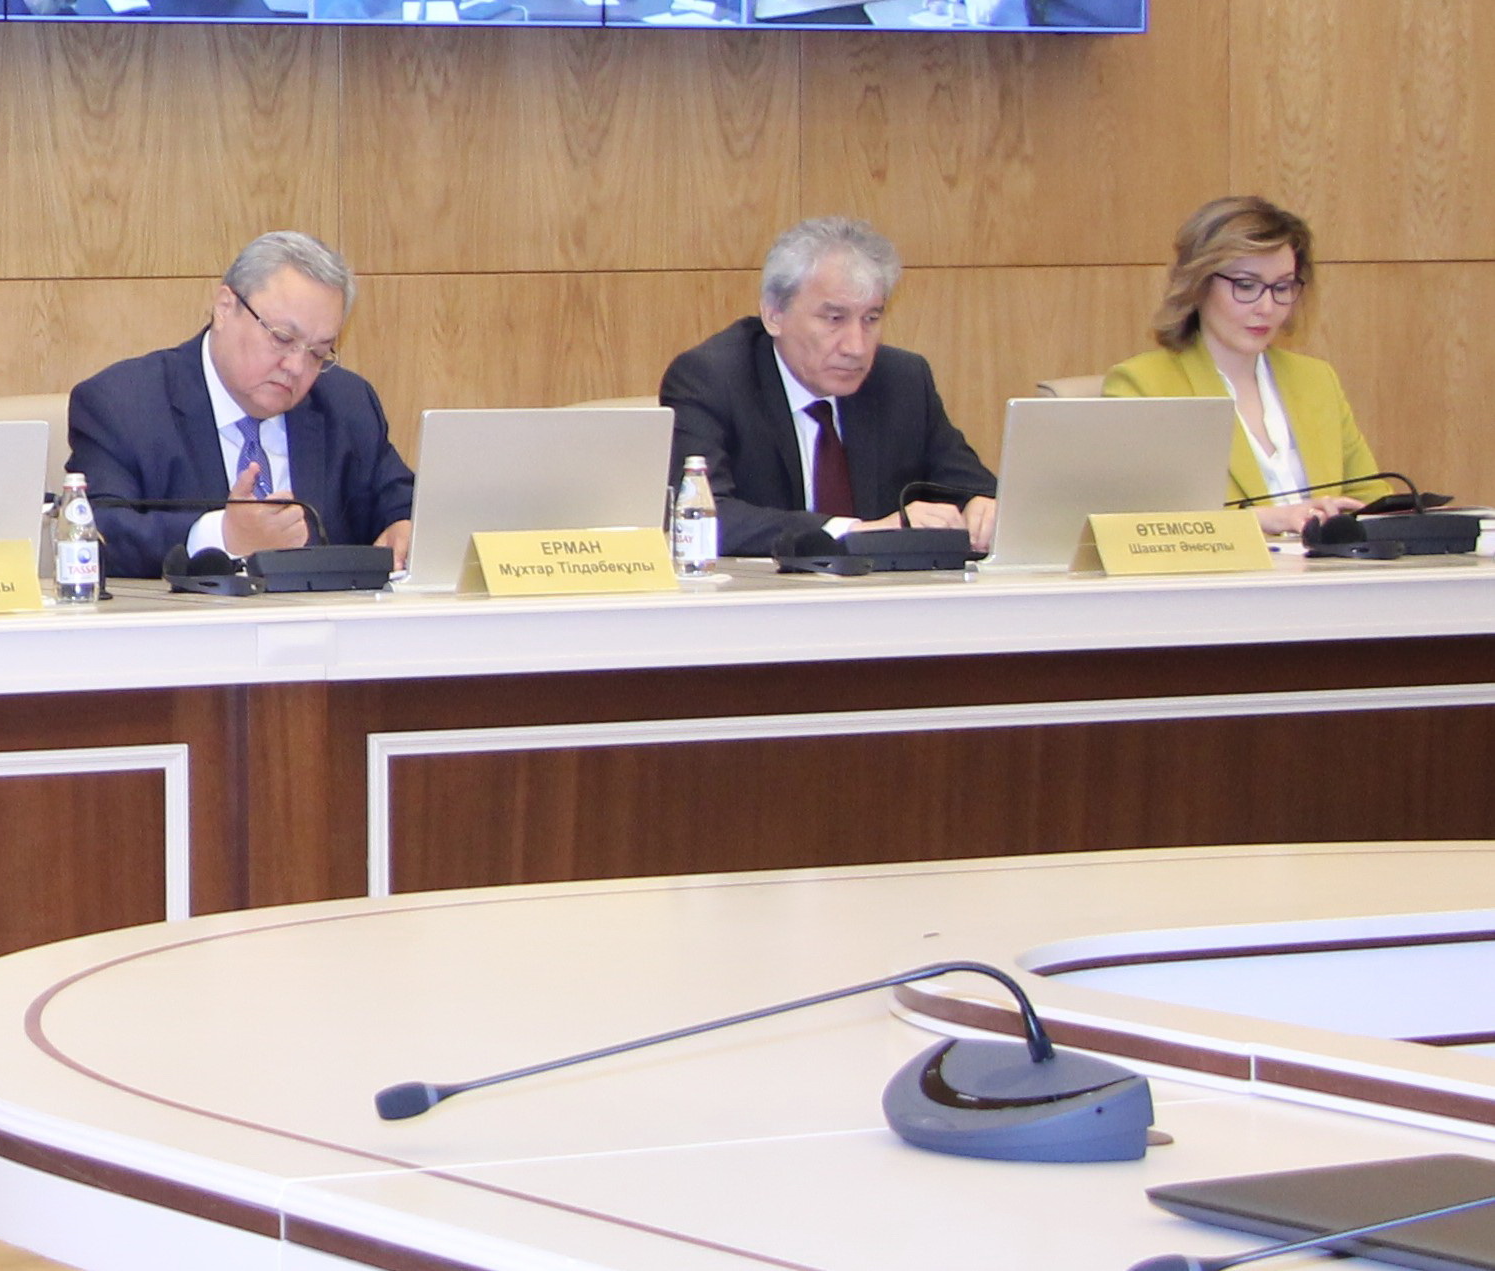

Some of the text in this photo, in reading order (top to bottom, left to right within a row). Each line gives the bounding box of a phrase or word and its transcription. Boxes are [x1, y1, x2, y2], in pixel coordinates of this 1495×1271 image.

[1136, 522, 1215, 537] ӨТЕМІСОВ
[541, 541, 602, 555] ЕРМАН
[1129, 543, 1176, 554] Шавхат
[499, 561, 655, 578] Мұхтар Тілдәбекұлы
